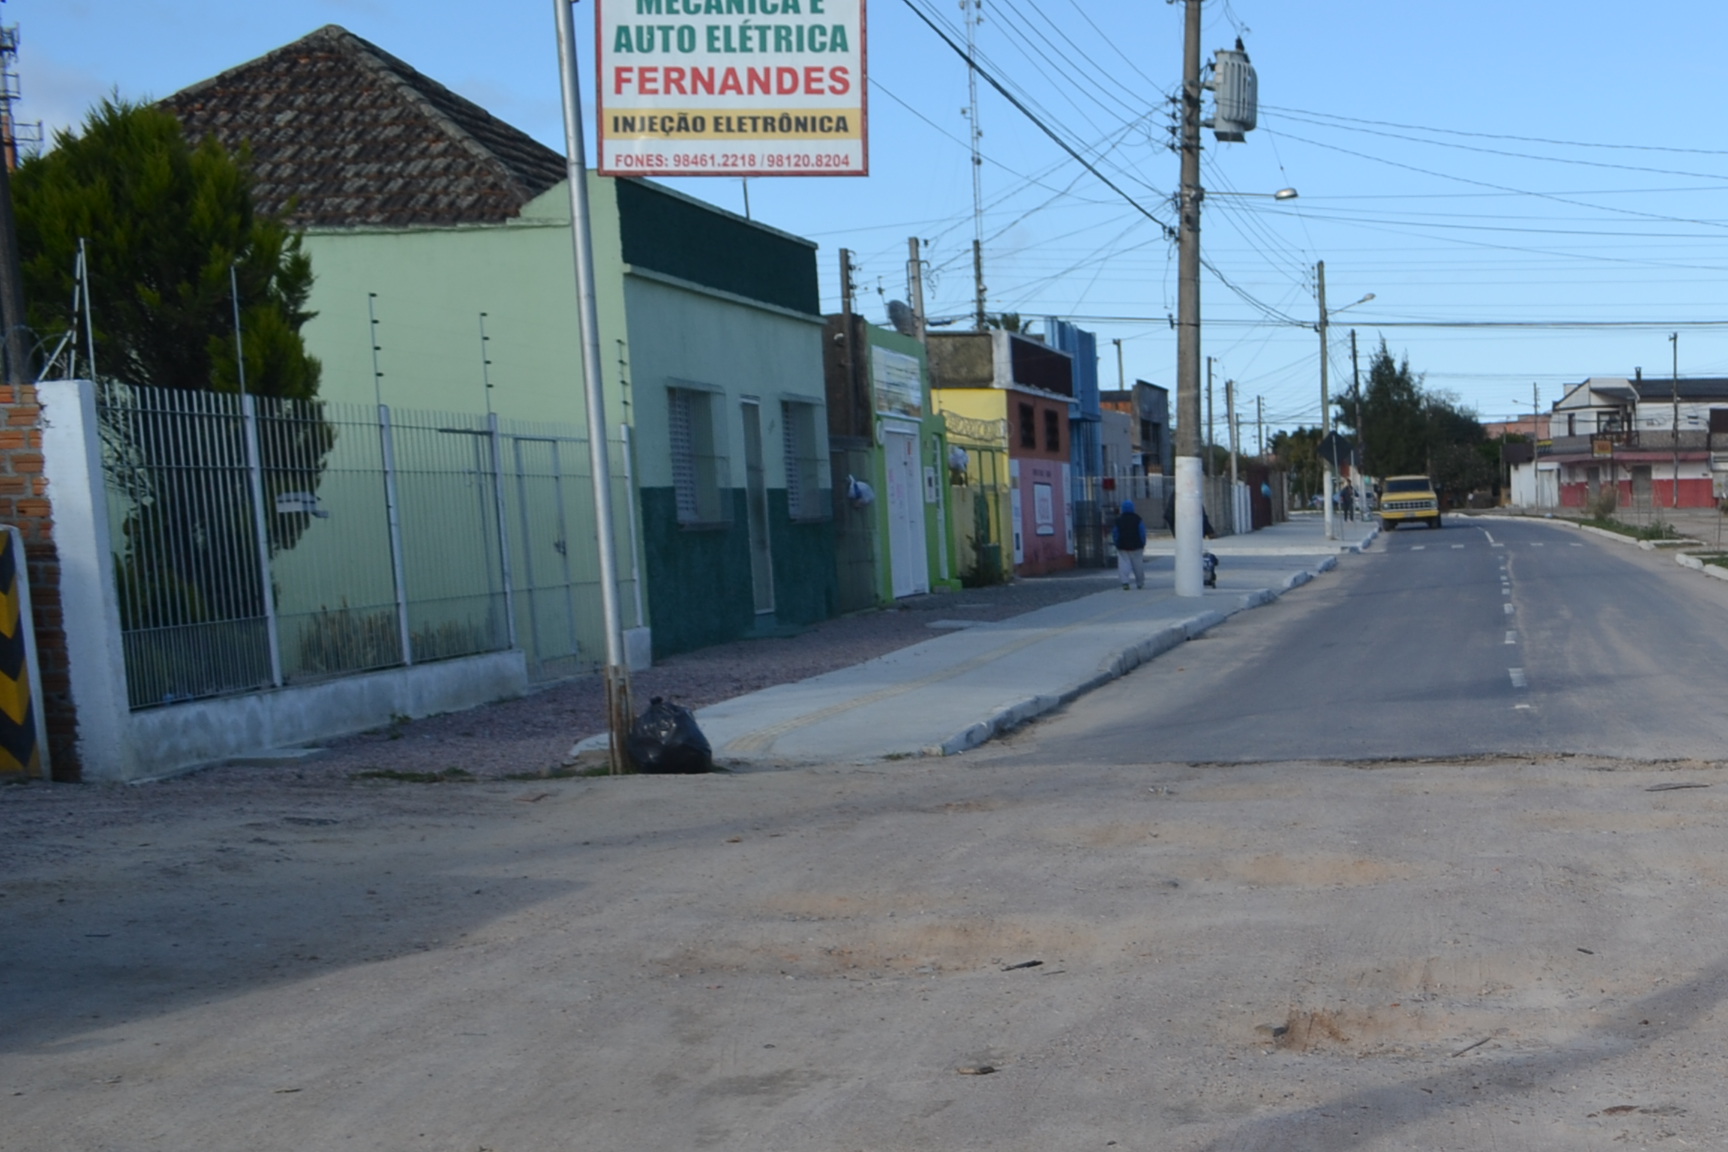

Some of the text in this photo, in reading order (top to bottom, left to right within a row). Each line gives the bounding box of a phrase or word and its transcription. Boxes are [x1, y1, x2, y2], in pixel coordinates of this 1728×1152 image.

[613, 19, 849, 53] AUTO ELÉTRICA
[614, 66, 850, 95] FERNANDES
[613, 112, 849, 136] INJEÇÃO ELETRÔNICA
[615, 154, 669, 167] FONES:
[673, 154, 756, 167] 98461.2218
